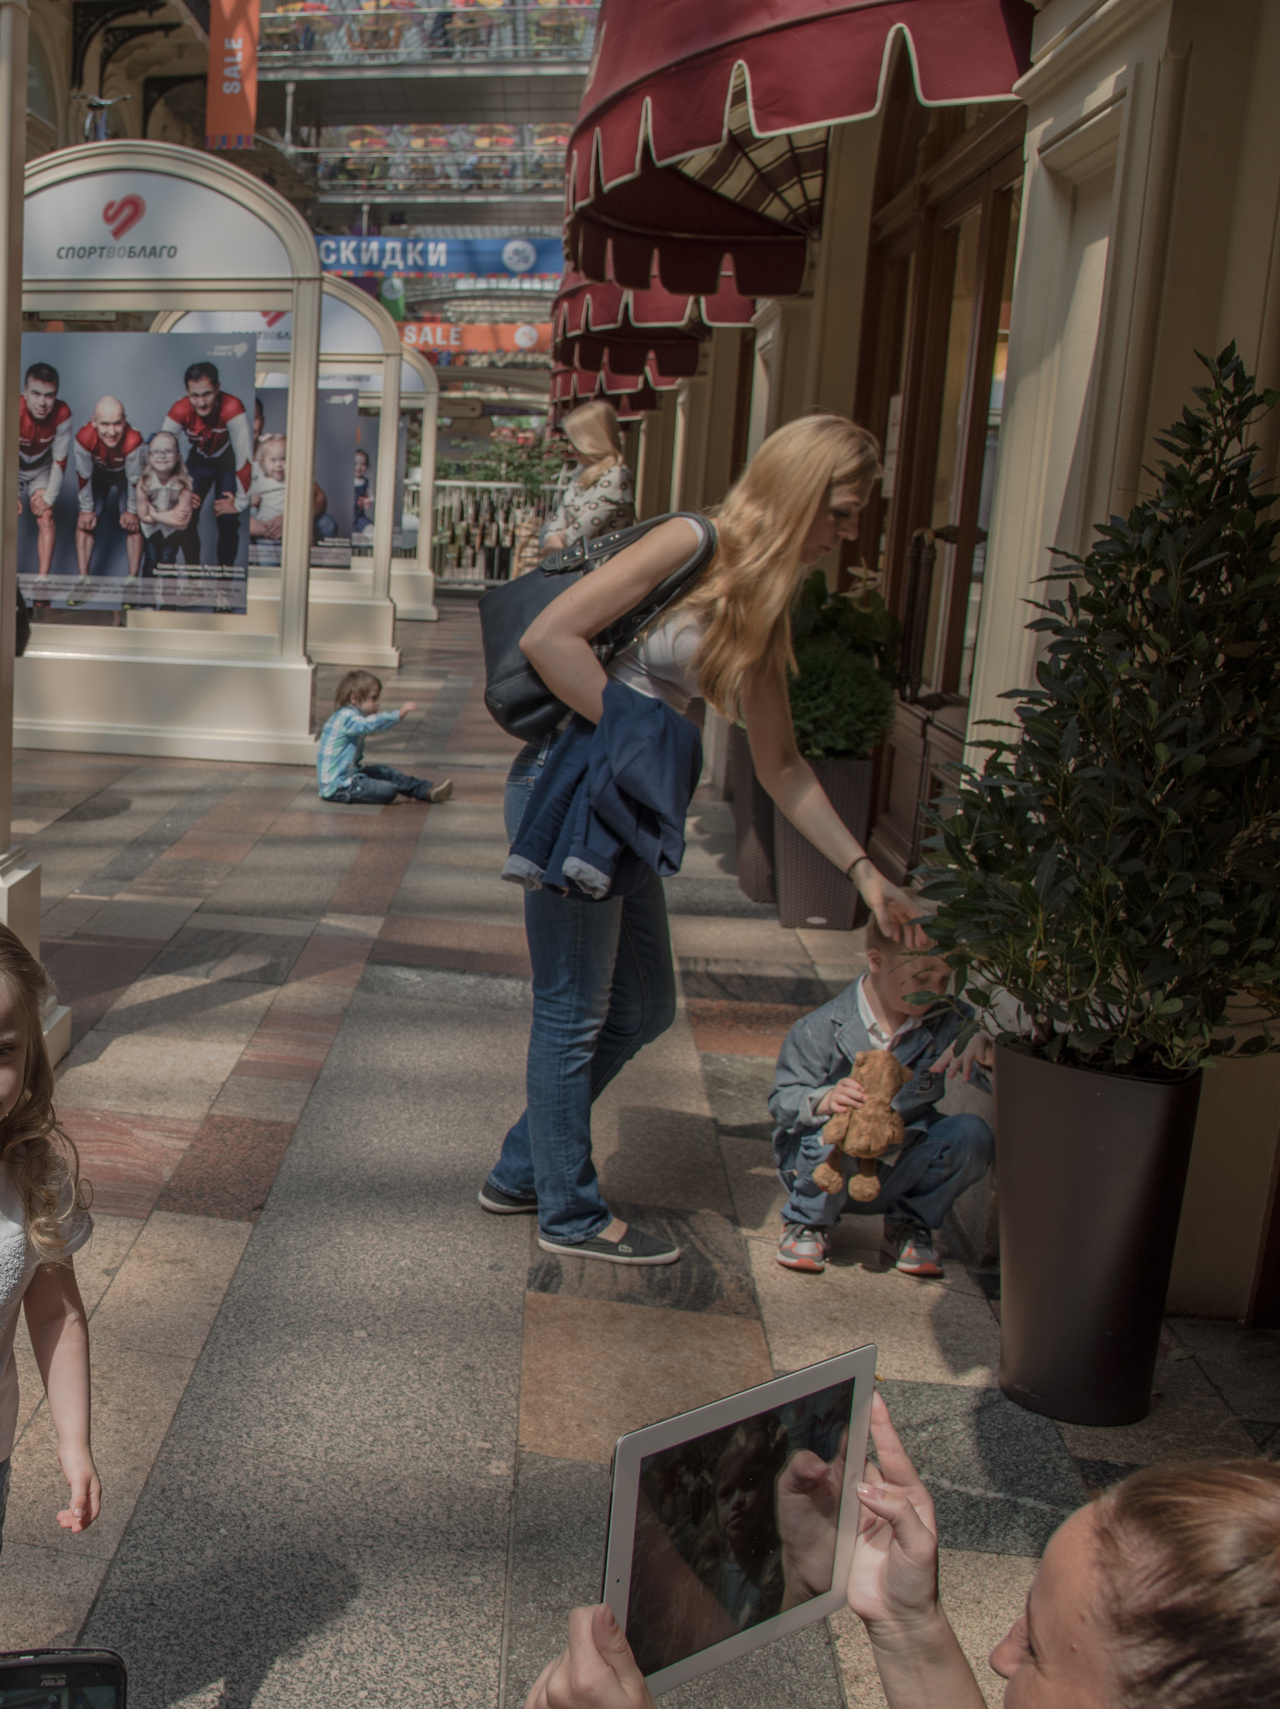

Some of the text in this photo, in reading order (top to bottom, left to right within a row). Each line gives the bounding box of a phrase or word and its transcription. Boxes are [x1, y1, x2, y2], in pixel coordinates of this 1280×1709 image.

[222, 37, 243, 94] SALE
[56, 245, 178, 259] СПОРТВОБЛАГО
[319, 239, 447, 270] СКИДКИ
[403, 325, 462, 345] SALE
